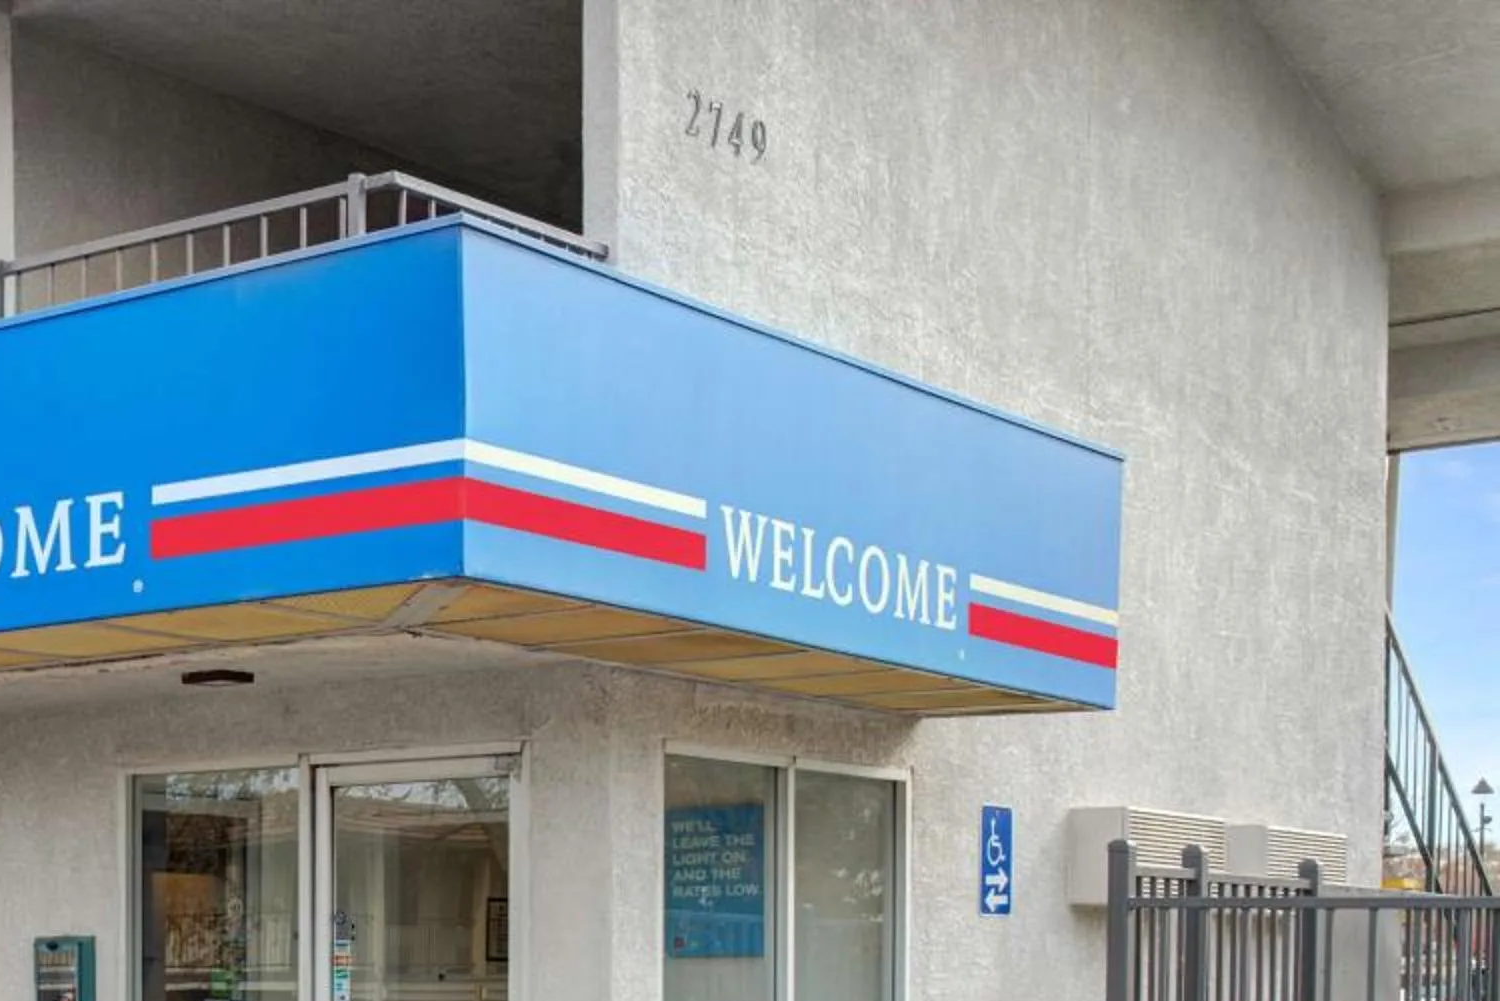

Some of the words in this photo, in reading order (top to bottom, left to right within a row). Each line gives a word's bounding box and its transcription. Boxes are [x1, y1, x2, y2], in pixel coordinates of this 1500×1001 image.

[685, 88, 767, 165] 2749
[720, 505, 957, 630] WELCOME
[672, 835, 720, 849] LEAVE
[724, 833, 755, 847] THE
[672, 851, 716, 866] LIGHT
[721, 850, 746, 864] ON
[673, 868, 707, 881] AND
[711, 866, 741, 880] THE
[725, 883, 759, 897] LOW
